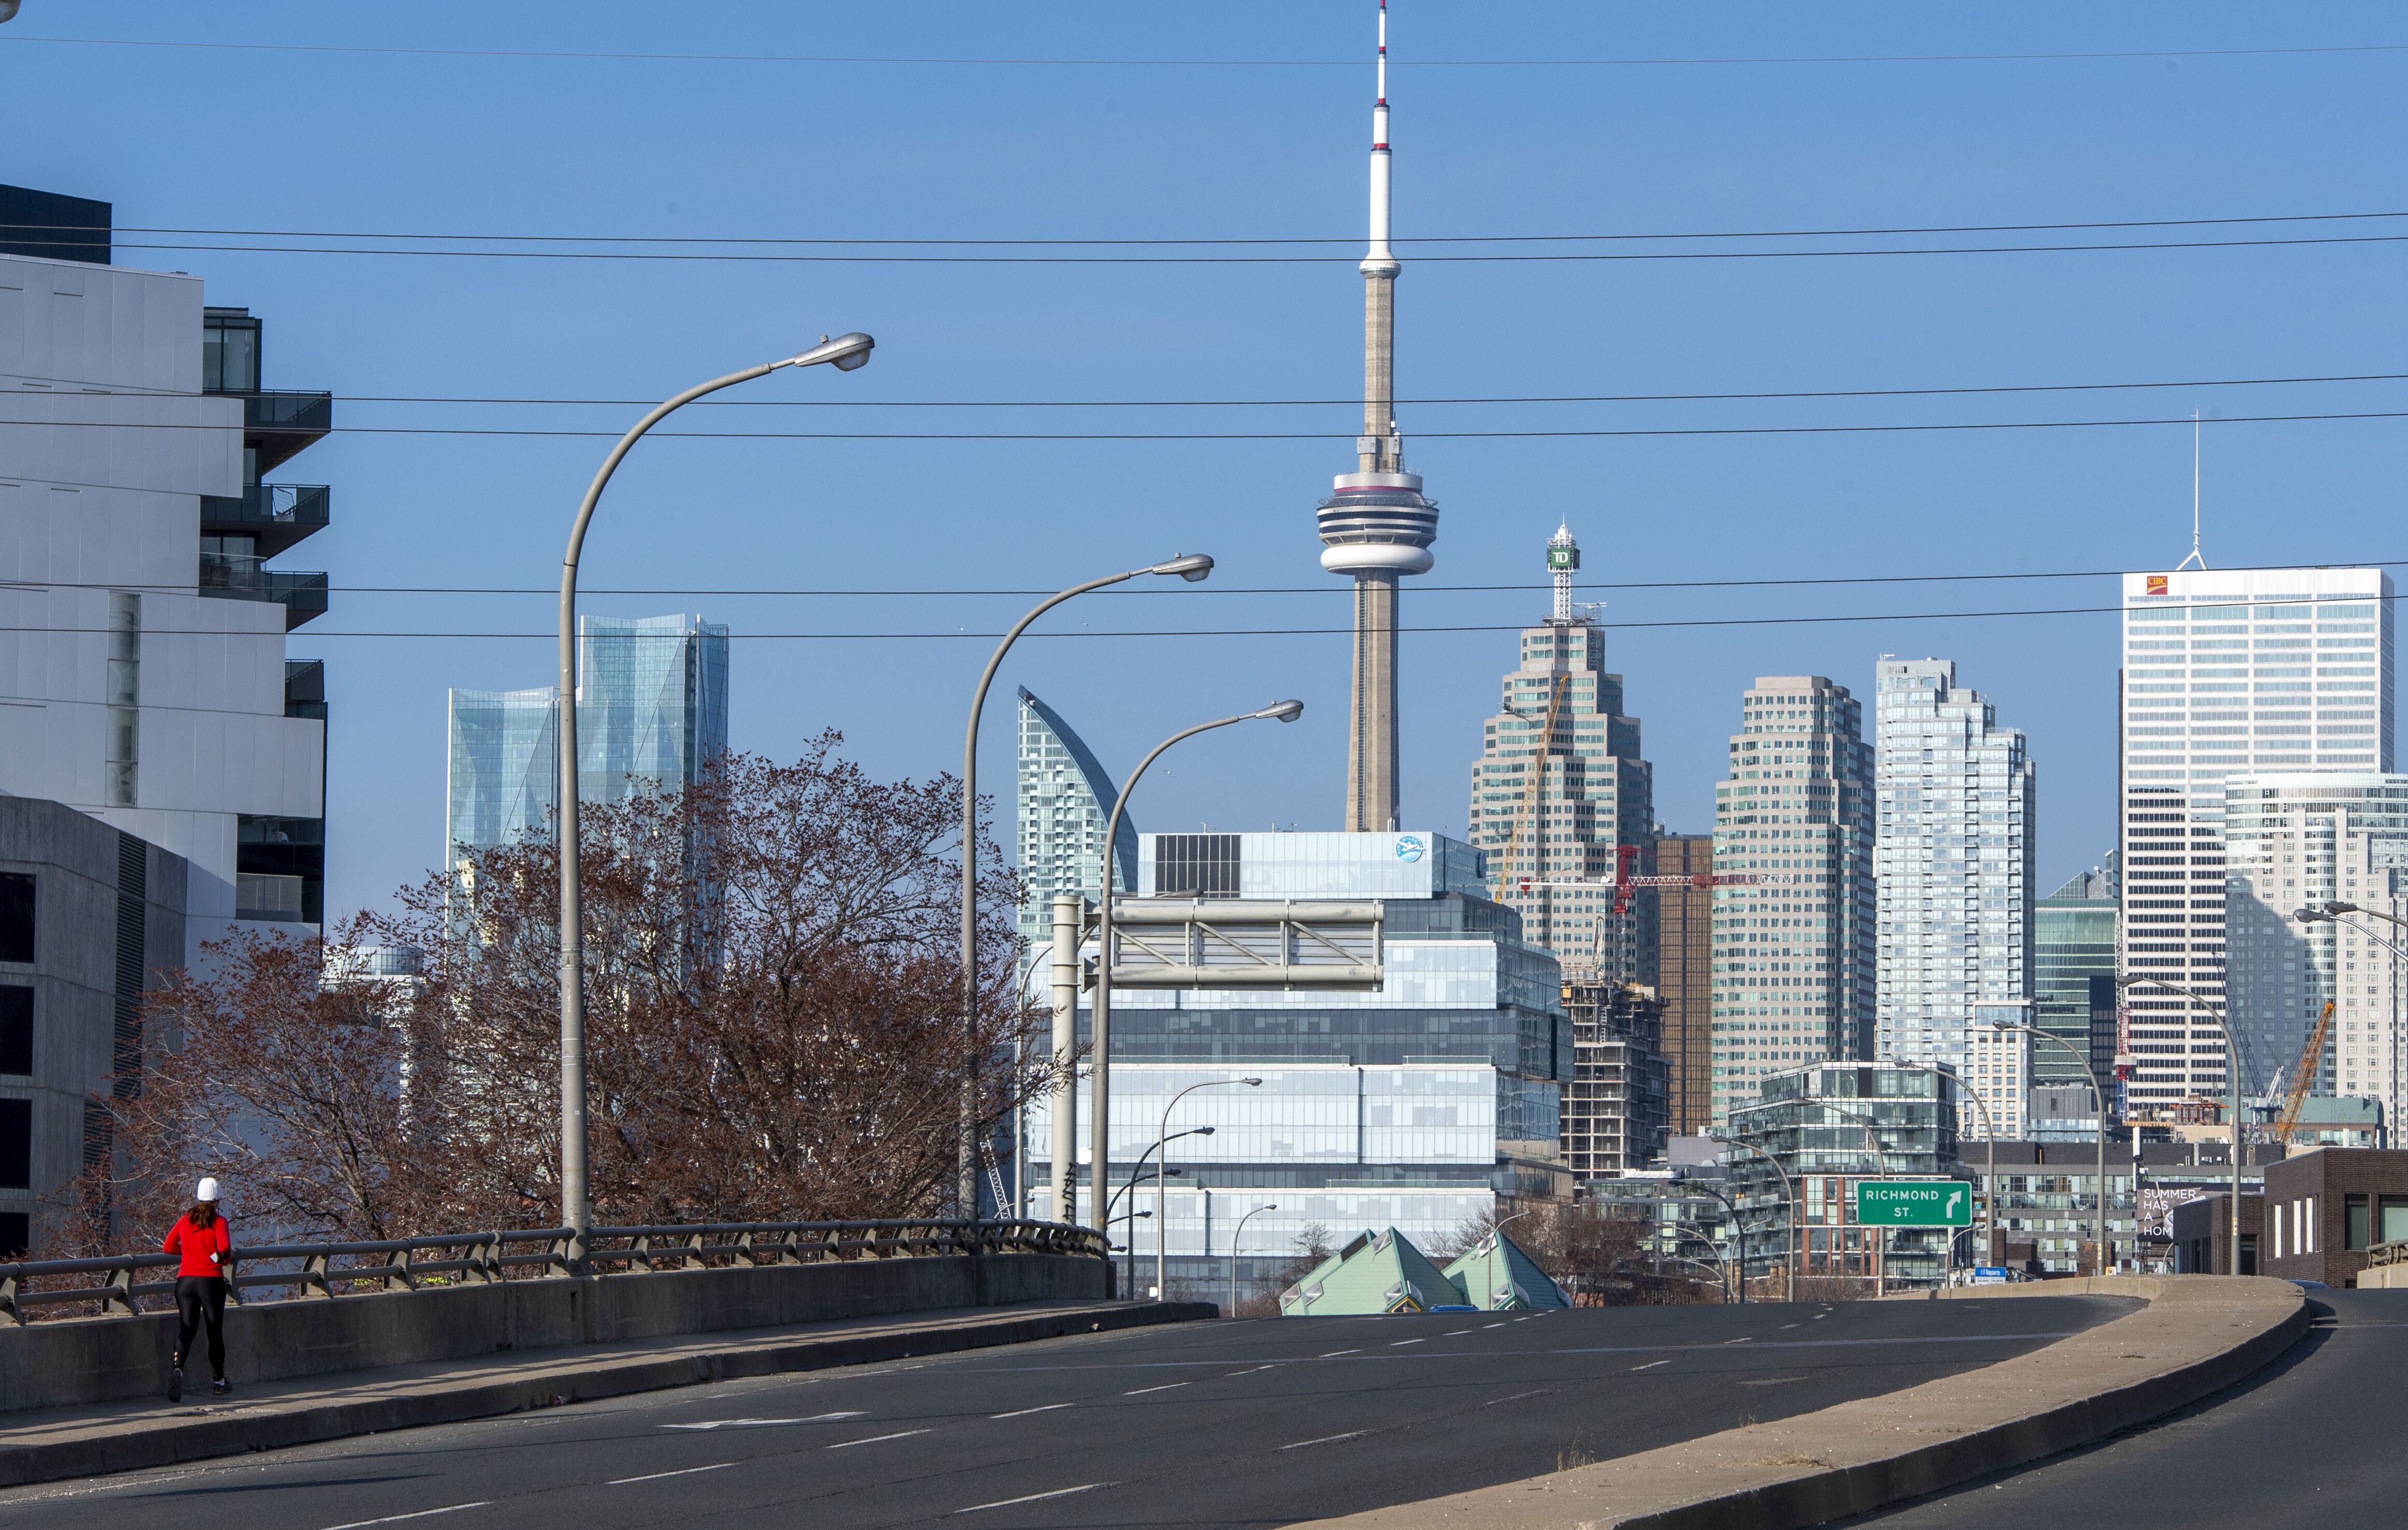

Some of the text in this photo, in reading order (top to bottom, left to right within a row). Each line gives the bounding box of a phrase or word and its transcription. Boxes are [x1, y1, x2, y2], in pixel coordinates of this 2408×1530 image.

[1553, 552, 1569, 563] TD
[1866, 1190, 1939, 1200] RICHMOND
[2144, 1189, 2196, 1199] SUMMER
[2144, 1201, 2168, 1210] HAS
[1894, 1207, 1913, 1217] ST.
[2144, 1212, 2153, 1221] A
